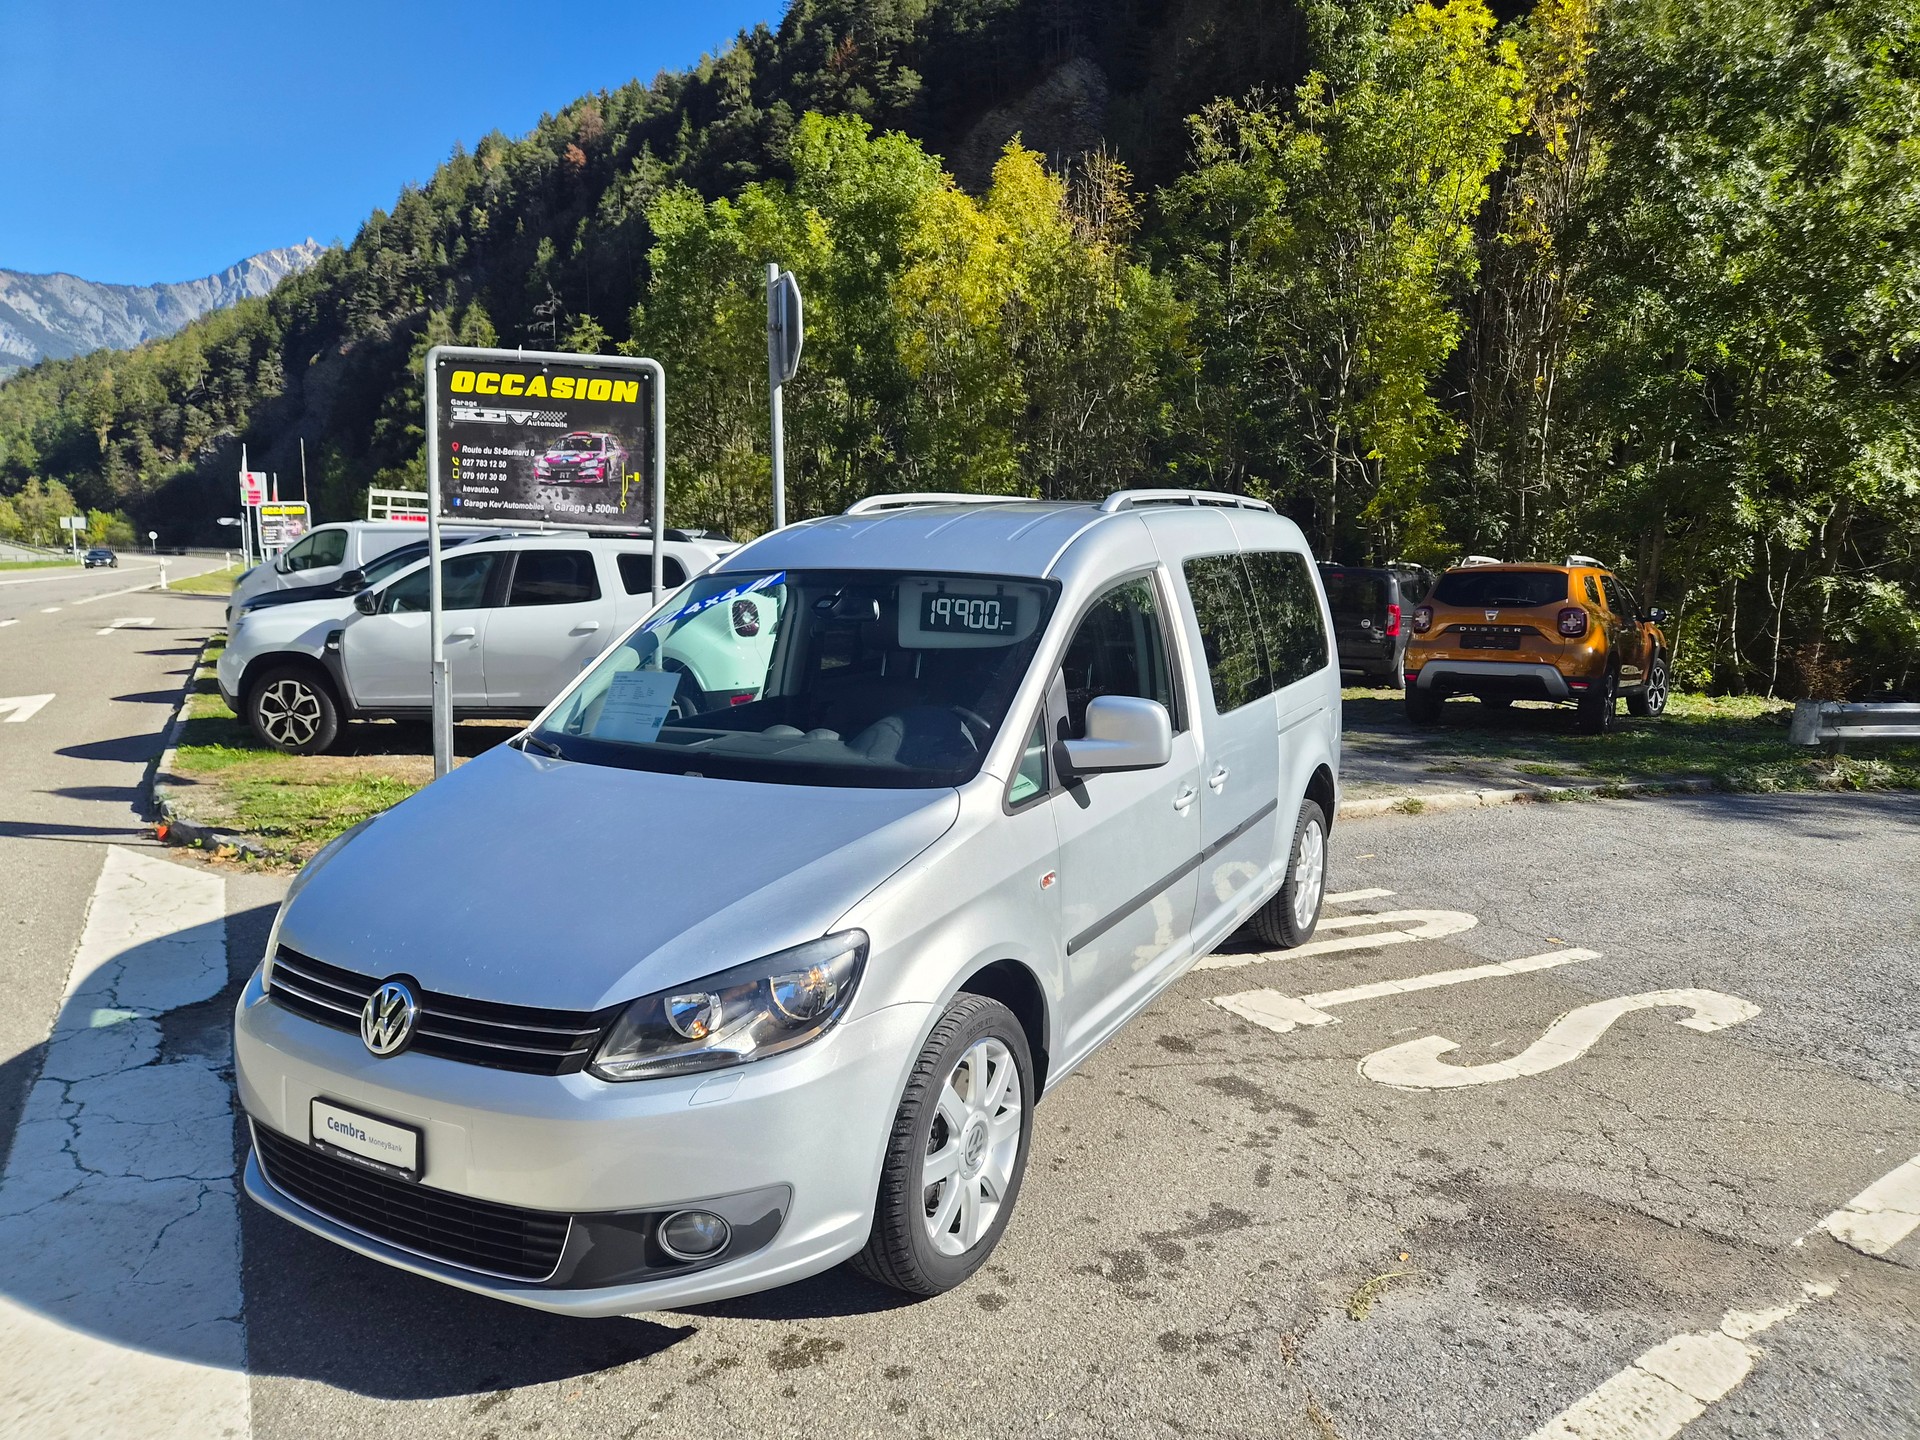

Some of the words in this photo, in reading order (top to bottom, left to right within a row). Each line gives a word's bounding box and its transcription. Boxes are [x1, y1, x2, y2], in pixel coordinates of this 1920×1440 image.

[450, 370, 639, 403] OCCASION
[450, 398, 478, 407] Garage
[527, 420, 568, 428] Automobile
[461, 445, 482, 454] Route
[483, 446, 492, 454] du
[493, 447, 529, 456] St-Bernard
[530, 449, 535, 457] 8
[462, 458, 474, 467] 027
[476, 459, 488, 467] 783
[498, 460, 507, 468] 50
[462, 471, 475, 480] 079
[476, 472, 487, 480] 101
[489, 472, 497, 481] 30
[498, 473, 507, 481] 50
[462, 484, 499, 494] kevauto.ch
[463, 499, 488, 509] Garage
[489, 500, 545, 510] Kev'Automobiles
[554, 502, 586, 514] Garage
[587, 503, 593, 513] à
[595, 503, 619, 514] 500m
[683, 589, 740, 615] 4x4
[327, 1116, 367, 1142] Cembra
[368, 1136, 403, 1153] MoneyBank
